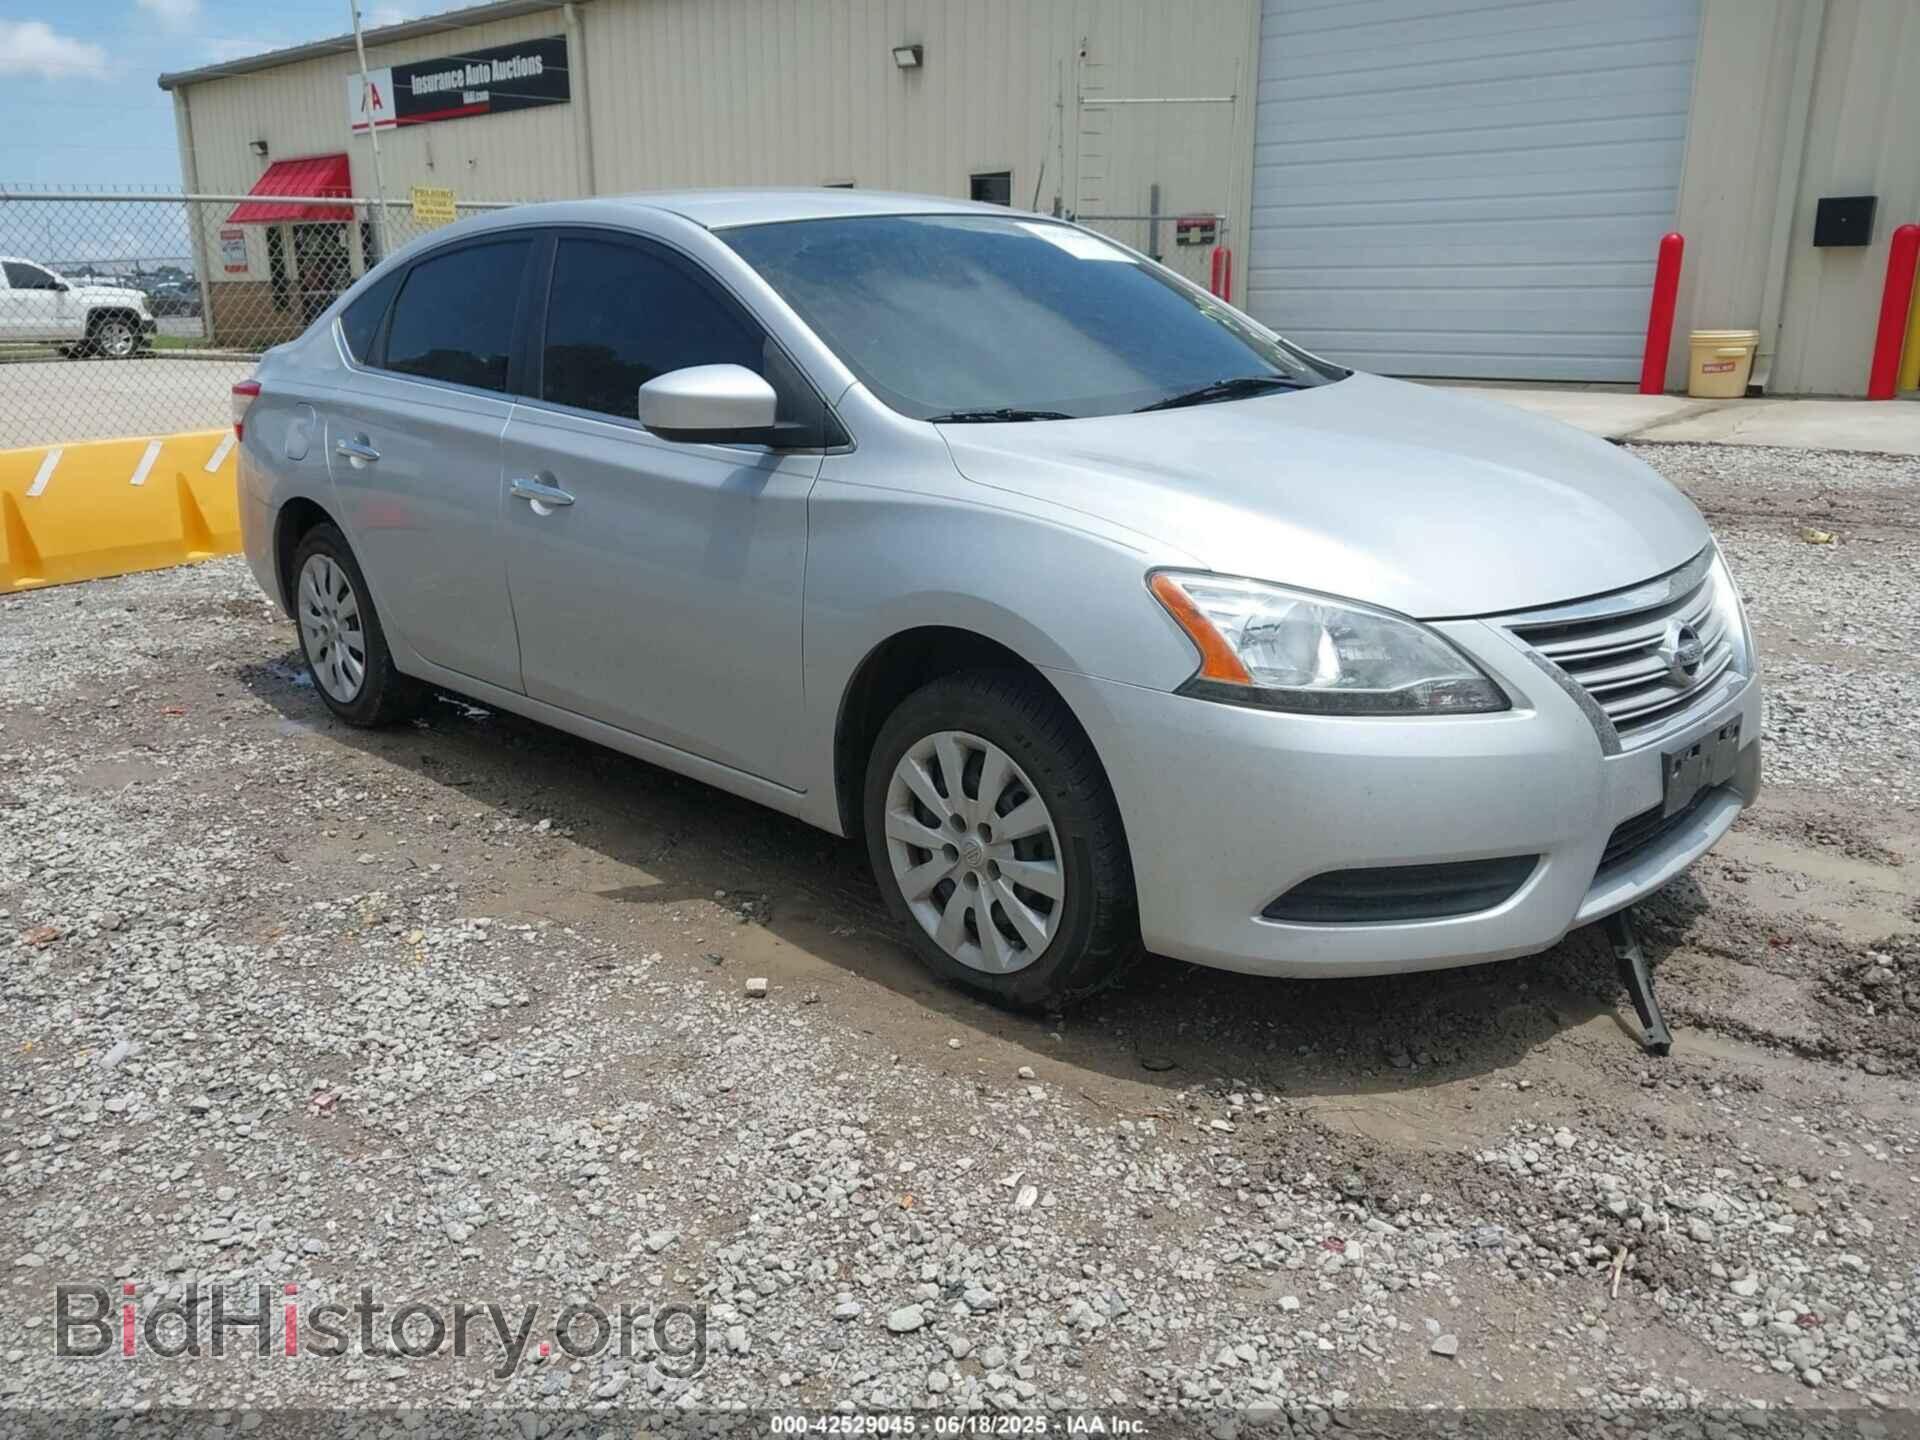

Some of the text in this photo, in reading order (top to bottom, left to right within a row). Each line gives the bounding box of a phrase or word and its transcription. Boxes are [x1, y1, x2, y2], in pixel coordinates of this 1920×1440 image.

[411, 54, 543, 95] Insurance Auto Auctions
